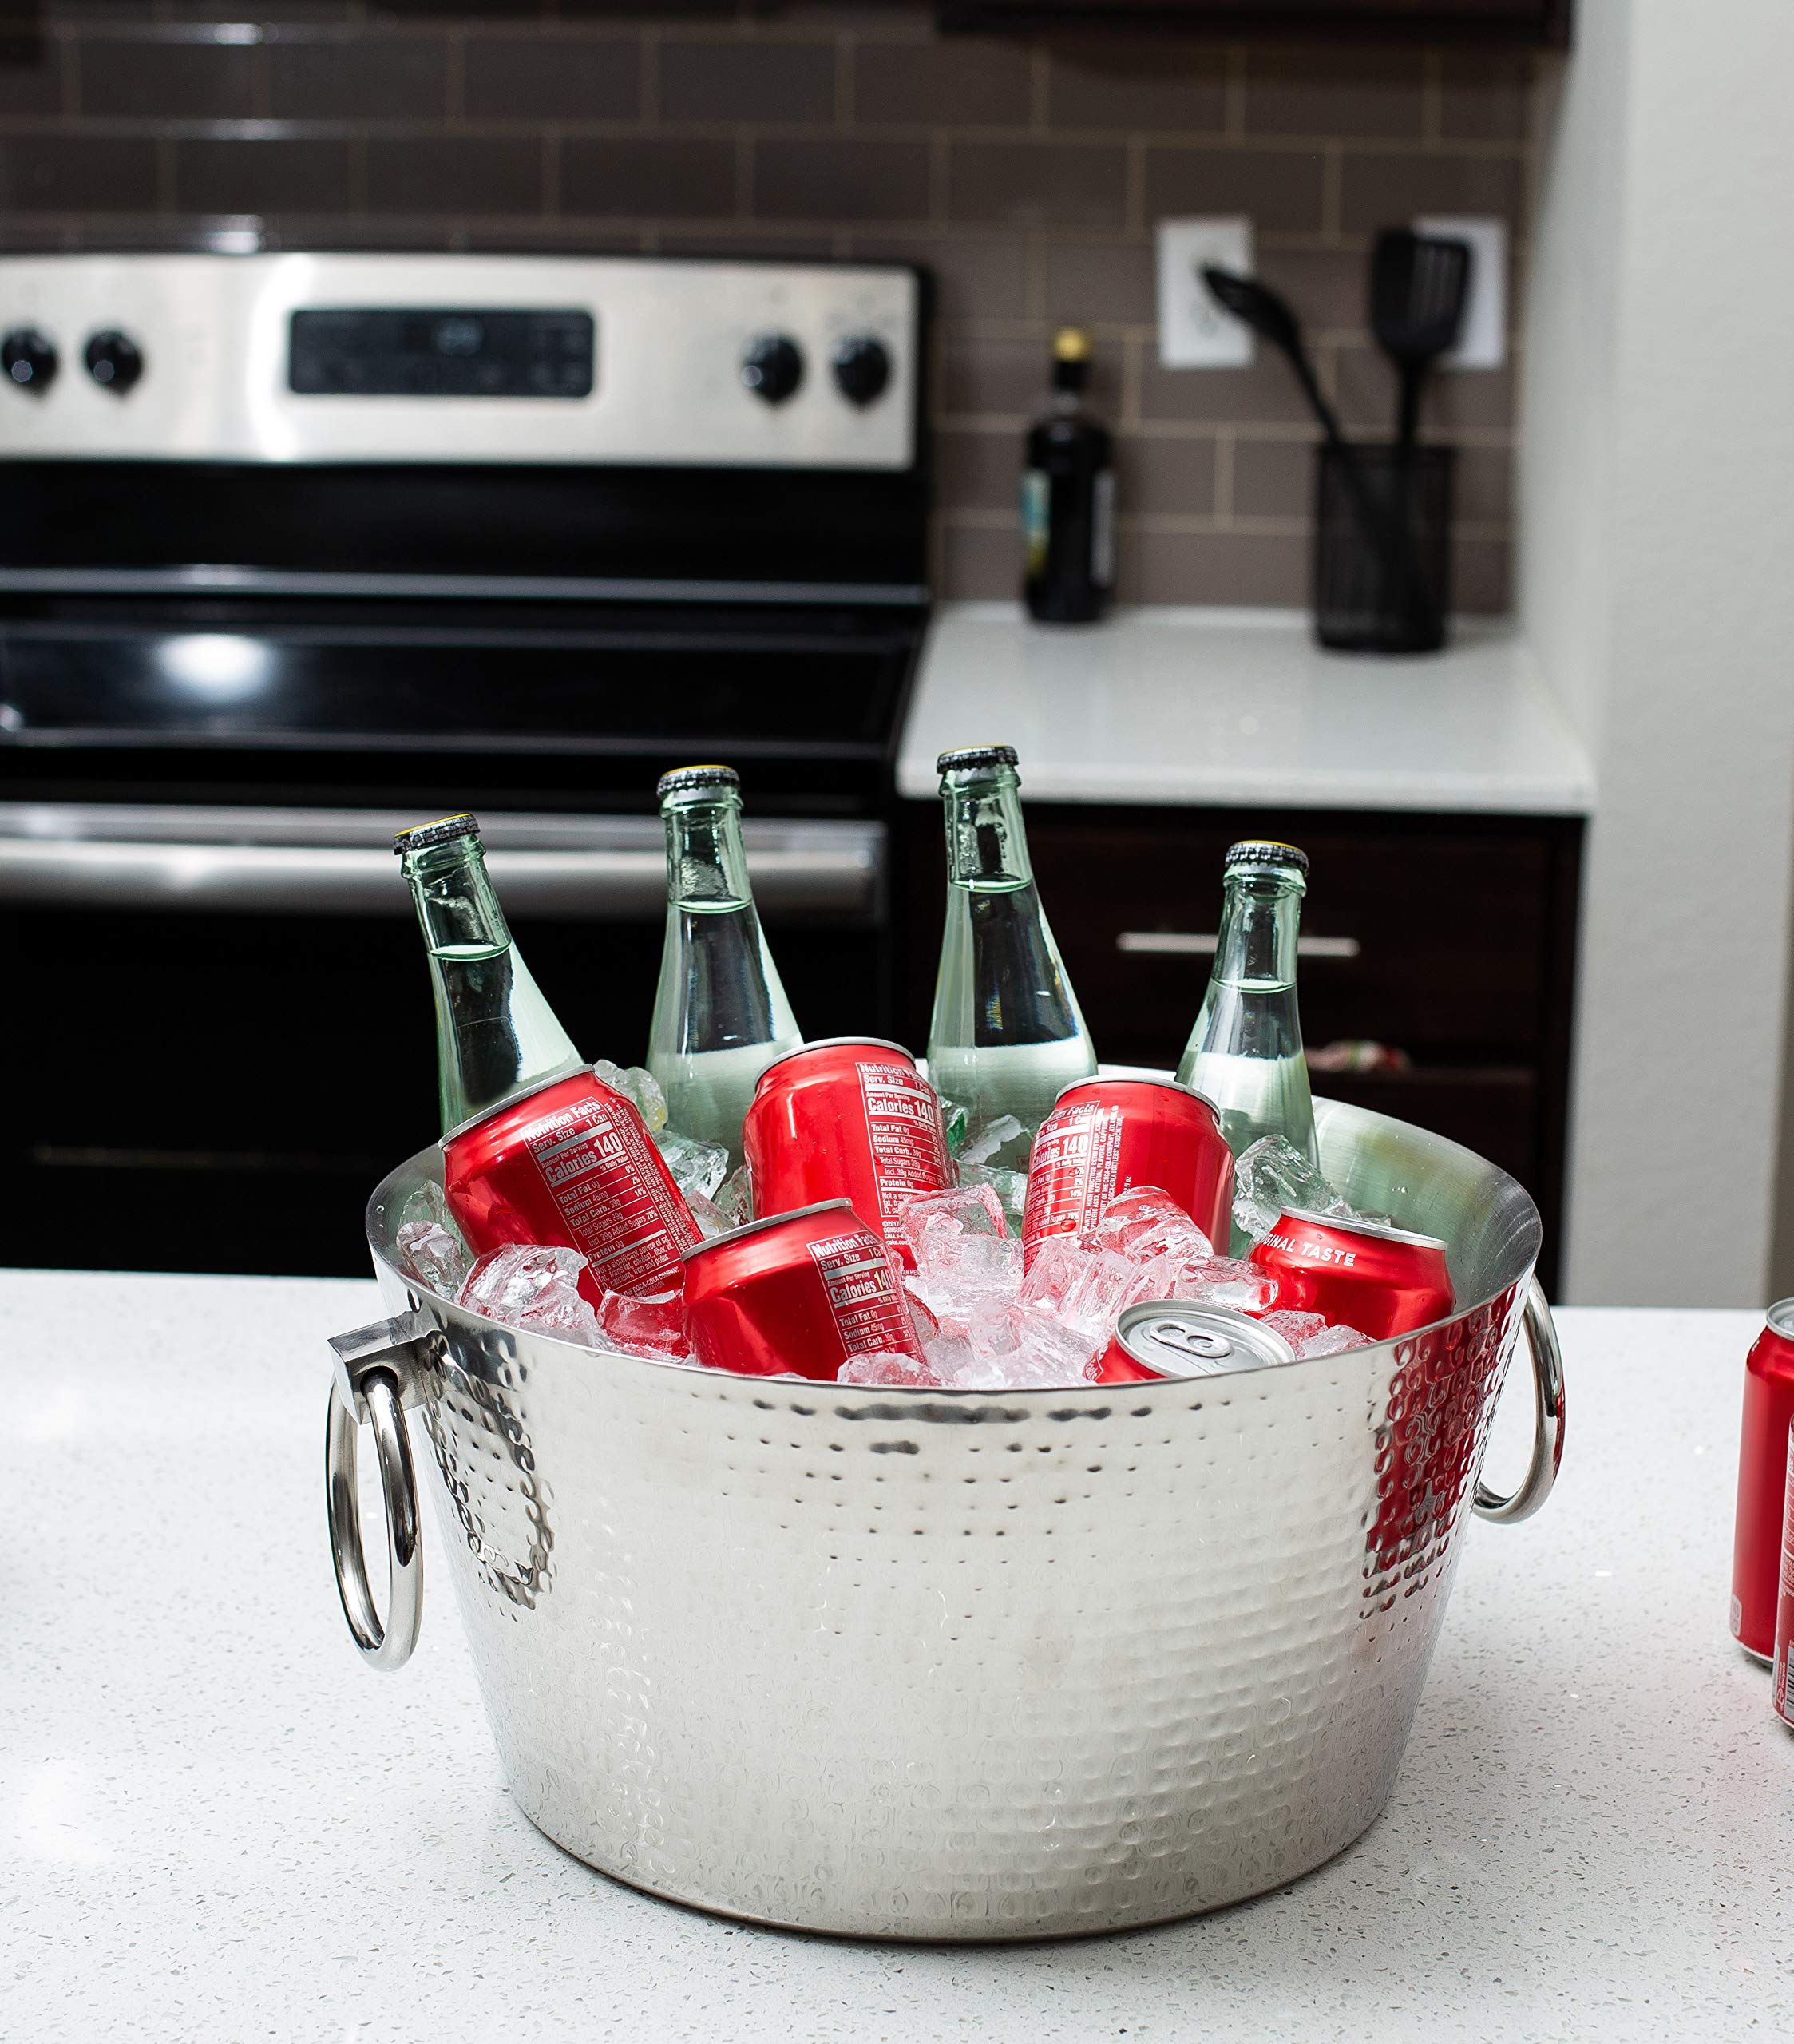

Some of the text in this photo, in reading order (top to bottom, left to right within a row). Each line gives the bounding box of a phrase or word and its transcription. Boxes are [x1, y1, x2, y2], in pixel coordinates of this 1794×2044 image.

[860, 1064, 905, 1075] Nutrition
[863, 1075, 885, 1083] Serv.
[887, 1075, 903, 1085] Size
[525, 1101, 601, 1142] Nutrition Facts
[604, 1101, 620, 1127] CARAMEL
[868, 1098, 934, 1123] Calories 140
[1067, 1104, 1095, 1115] Facts
[532, 1113, 608, 1153] Serv. Size 1 Can
[618, 1126, 631, 1146] SYRUP,
[901, 1137, 913, 1146] 45mg
[541, 1143, 588, 1167] Amount Per Serving
[545, 1132, 623, 1182] Calories 140
[628, 1136, 644, 1162] FLAVORS,
[628, 1145, 639, 1161] CORN
[894, 1147, 912, 1155] Carb.
[913, 1149, 921, 1158] 39g
[1033, 1146, 1060, 1169] Calories
[1063, 1135, 1088, 1155] 140
[1095, 1142, 1106, 1168] FLAVORS,
[605, 1159, 617, 1169] Daily
[636, 1160, 652, 1188] FRUCTOSE
[641, 1162, 656, 1186] NATURAL
[897, 1169, 907, 1178] 39g
[908, 1170, 922, 1179] Added
[911, 1159, 920, 1168] 39g
[1103, 1157, 1112, 1182] COCA-COLA
[559, 1164, 635, 1204] Total Fat 0g 0%
[1087, 1165, 1097, 1193] FRUCTOSE
[1094, 1168, 1103, 1192] NATURAL
[564, 1175, 640, 1216] Sodium 45mg 2%
[570, 1186, 646, 1227] Total Carb. 39g 14%
[650, 1188, 659, 1202] HIGH
[657, 1202, 670, 1222] WATER,
[662, 1201, 681, 1235] PHOSPHORIC
[1089, 1208, 1098, 1228] PHORIC
[579, 1212, 624, 1237] Total Sugars 39g
[588, 1210, 658, 1247] Incl. 39g Added Sugars 78%
[667, 1222, 684, 1251] RBONATED
[588, 1244, 616, 1262] Protein
[595, 1266, 606, 1276] Not
[611, 1250, 639, 1267] significant
[638, 1242, 656, 1255] source
[655, 1238, 661, 1246] of
[811, 1238, 859, 1258] Nutrition
[820, 1249, 873, 1270] Serv. Size 1
[1301, 1242, 1356, 1267] TASTE
[598, 1274, 609, 1283] fat,
[609, 1266, 624, 1278] trans
[623, 1262, 634, 1270] fat,
[653, 1246, 667, 1256] fiber,
[610, 1272, 634, 1286] calcium,
[633, 1266, 645, 1275] iron
[644, 1260, 655, 1270] and
[655, 1254, 670, 1266] potas.
[632, 1276, 659, 1293] COCA-COLA
[827, 1277, 846, 1287] Amount
[854, 1271, 870, 1281] Serving
[830, 1269, 894, 1302] Calories 140
[839, 1310, 877, 1327] Total Fat 0g
[843, 1322, 884, 1339] Sodium 45mg
[847, 1340, 866, 1352] Total
[867, 1336, 885, 1347] Carb.
